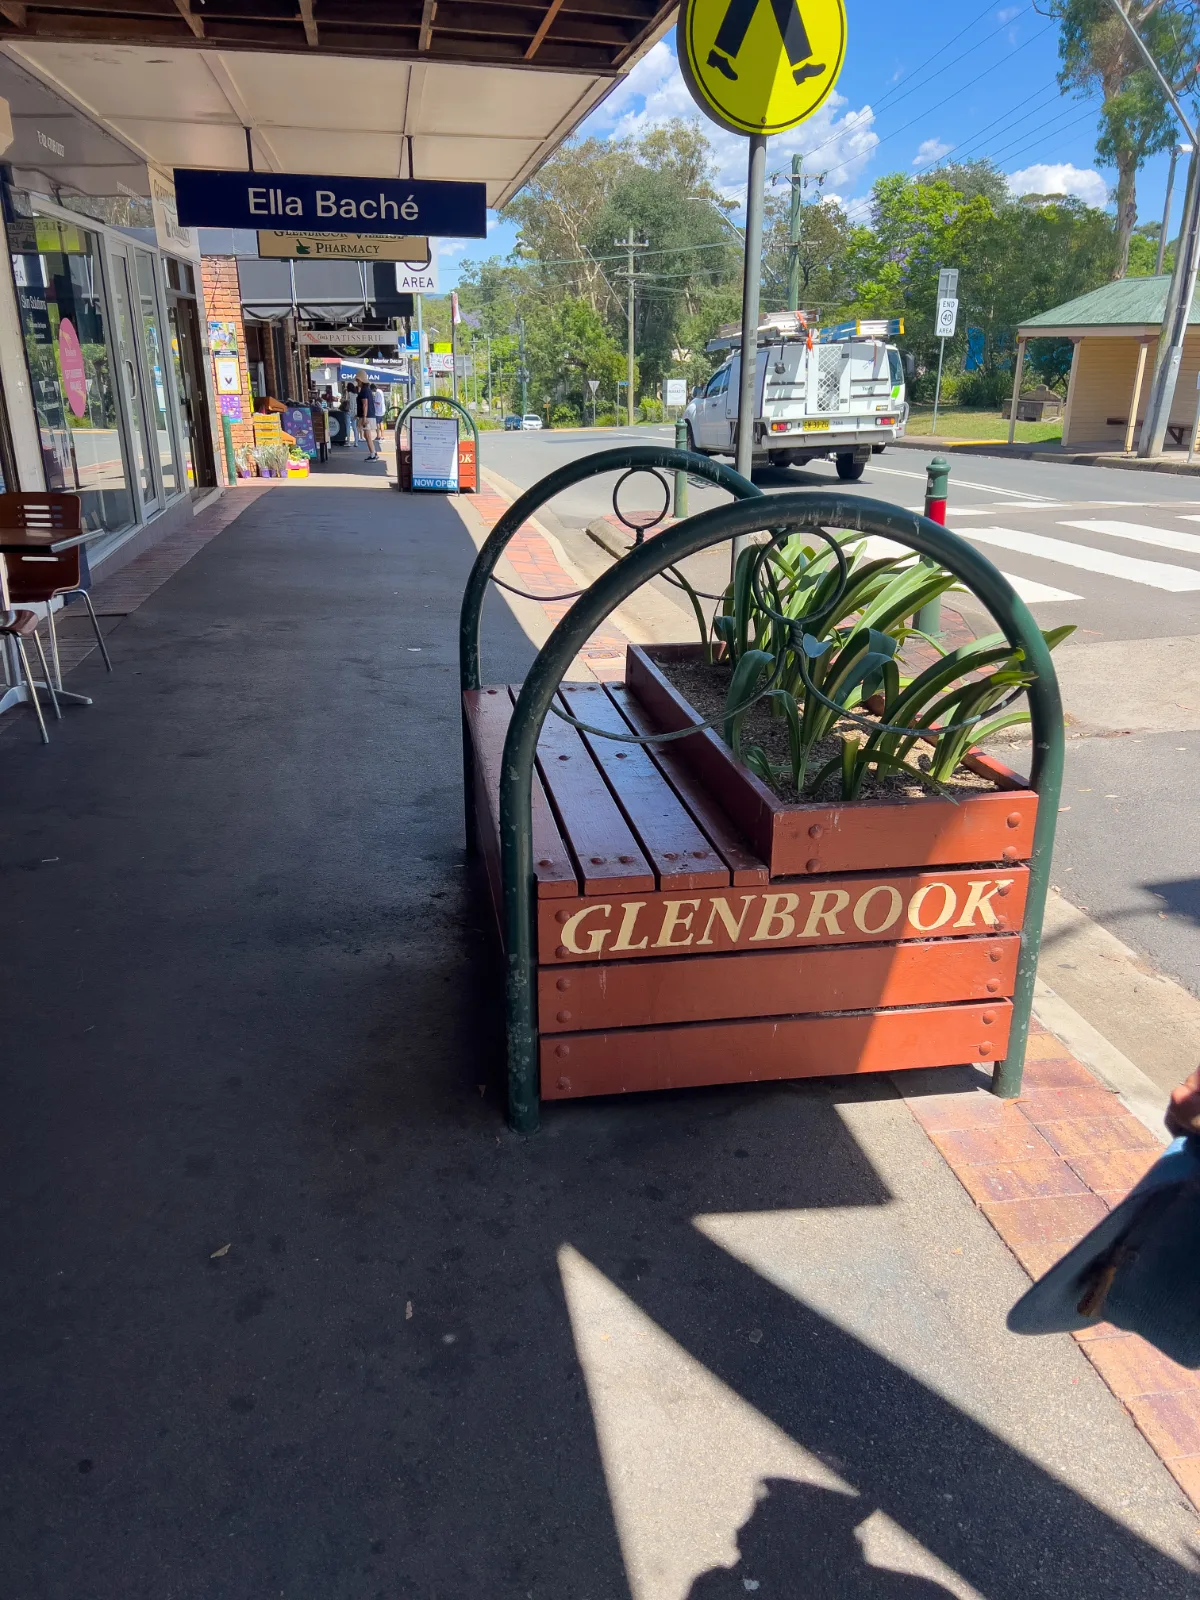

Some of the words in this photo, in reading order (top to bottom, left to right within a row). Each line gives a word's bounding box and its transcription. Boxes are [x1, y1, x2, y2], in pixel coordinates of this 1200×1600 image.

[247, 187, 304, 216] Ella
[315, 190, 420, 221] Baché
[315, 242, 380, 254] PHARMACY
[402, 276, 435, 288] AREA
[341, 373, 380, 381] CHAN
[414, 479, 435, 487] NOW
[435, 480, 458, 488] OPEN
[560, 879, 1015, 955] GLENBROOK
